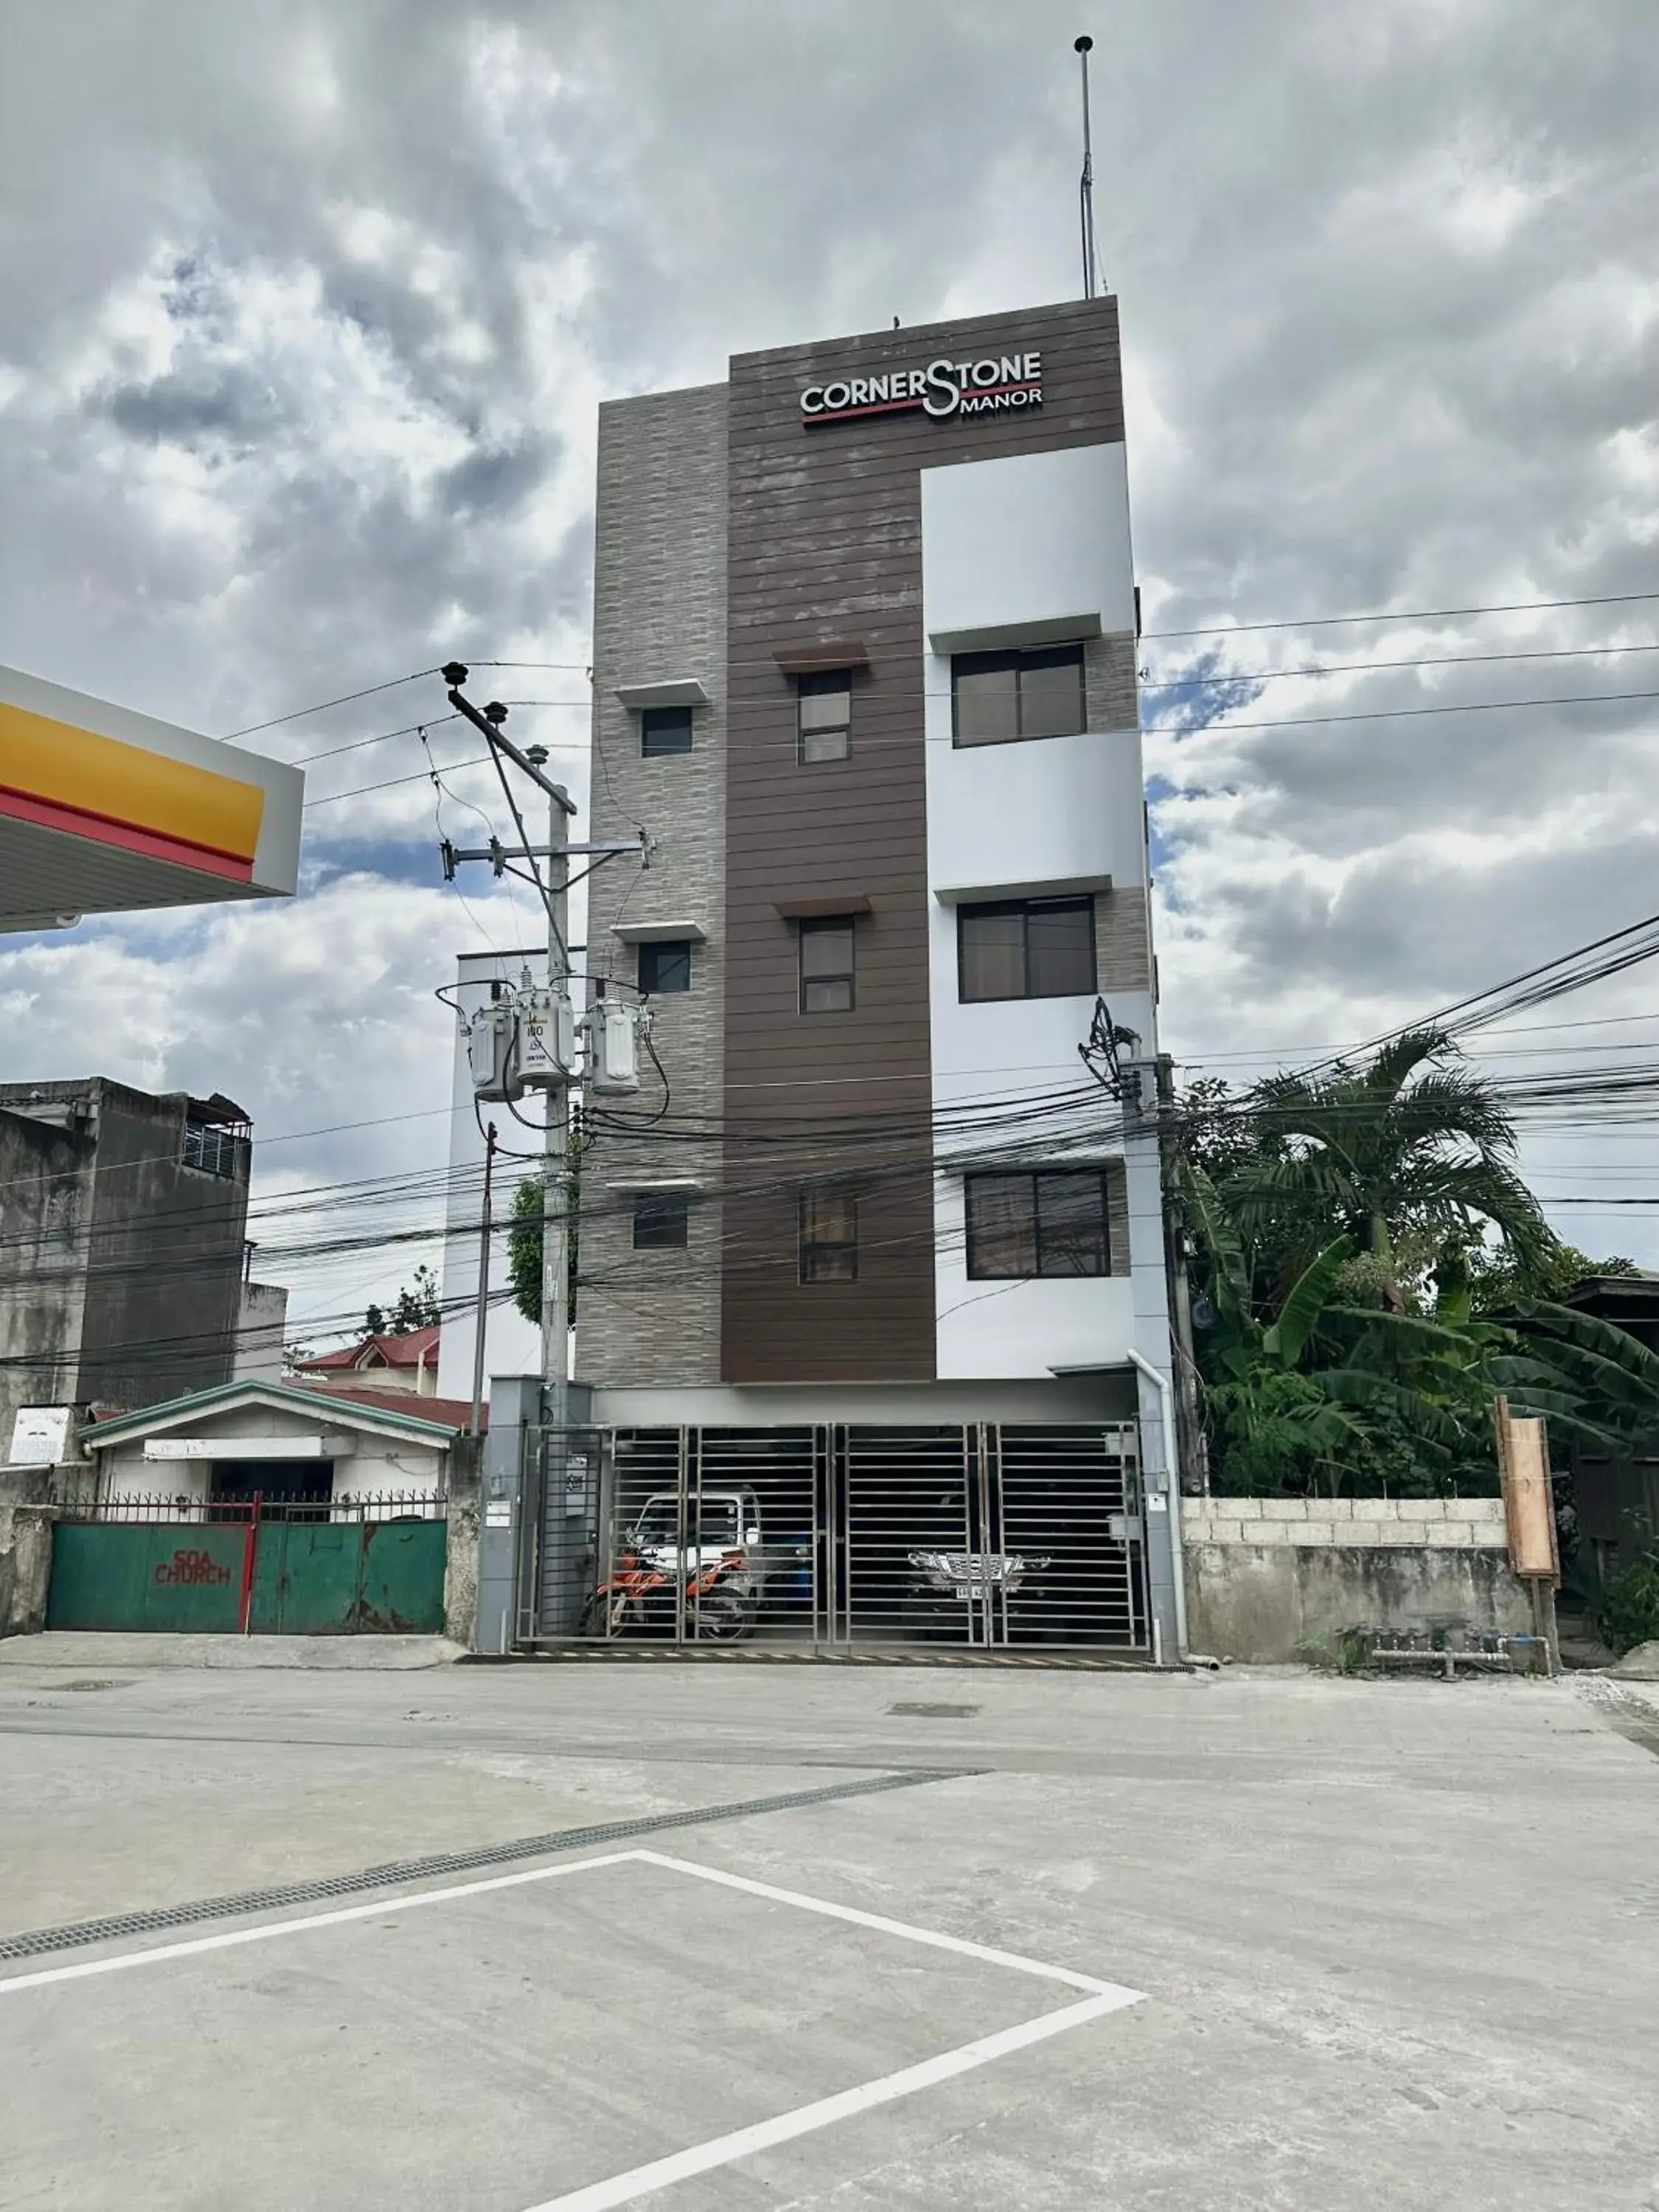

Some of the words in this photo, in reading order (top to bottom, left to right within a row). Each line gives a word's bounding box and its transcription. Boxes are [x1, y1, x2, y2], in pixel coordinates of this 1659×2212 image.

[800, 352, 1041, 417] CORNERSTONE
[959, 388, 1043, 414] MANOR
[156, 1562, 231, 1585] CHURCH
